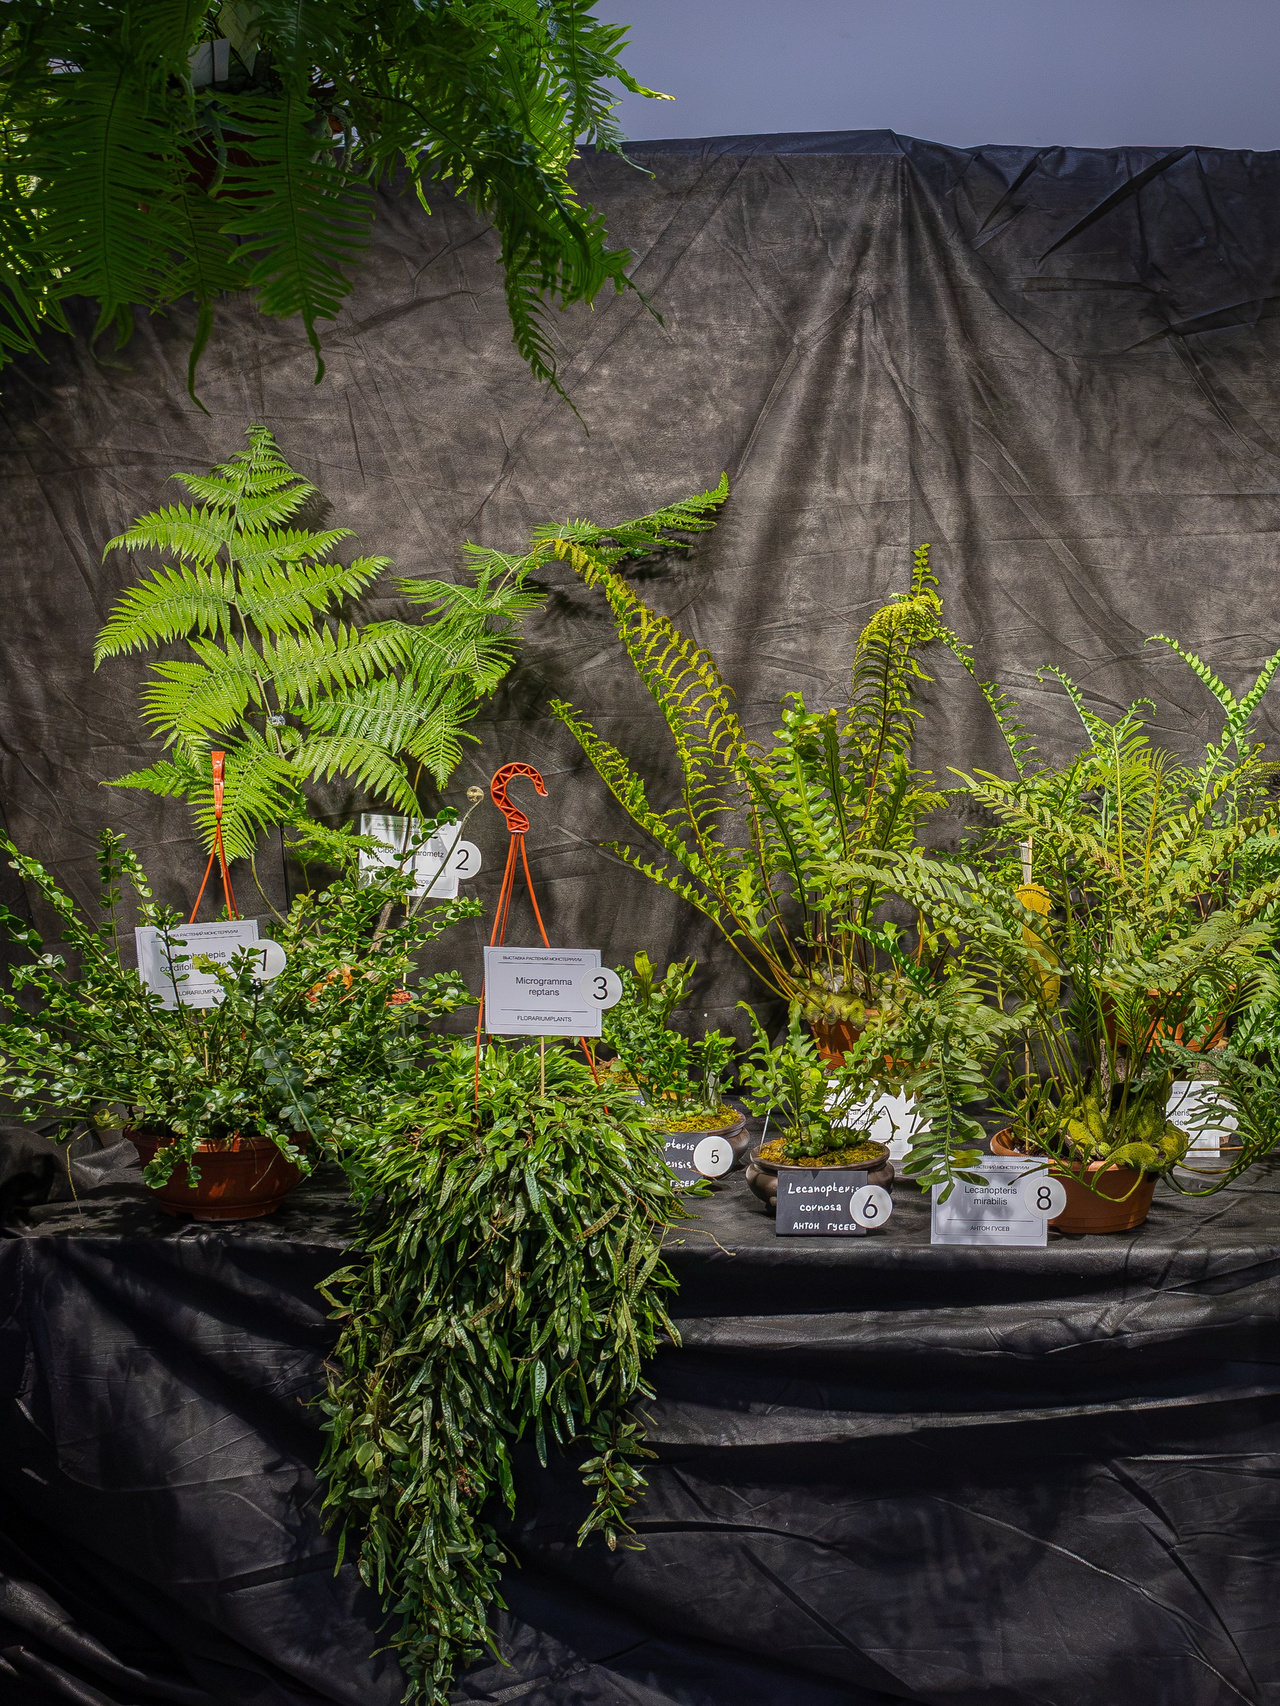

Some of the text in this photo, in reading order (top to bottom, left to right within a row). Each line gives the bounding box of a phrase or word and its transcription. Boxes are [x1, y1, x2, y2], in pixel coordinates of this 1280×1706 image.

[455, 848, 469, 871] 2
[515, 976, 573, 987] Microgramma
[528, 988, 560, 997] reptans
[592, 976, 609, 1000] 3
[710, 1149, 720, 1164] 5
[964, 1185, 1018, 1195] Lecanopteris
[973, 1197, 1008, 1206] mirabilis
[1036, 1185, 1052, 1211] 8
[799, 1203, 842, 1212] cornosa
[862, 1194, 878, 1219] 6
[792, 1221, 857, 1231] АНТОН ГУСЕВ
